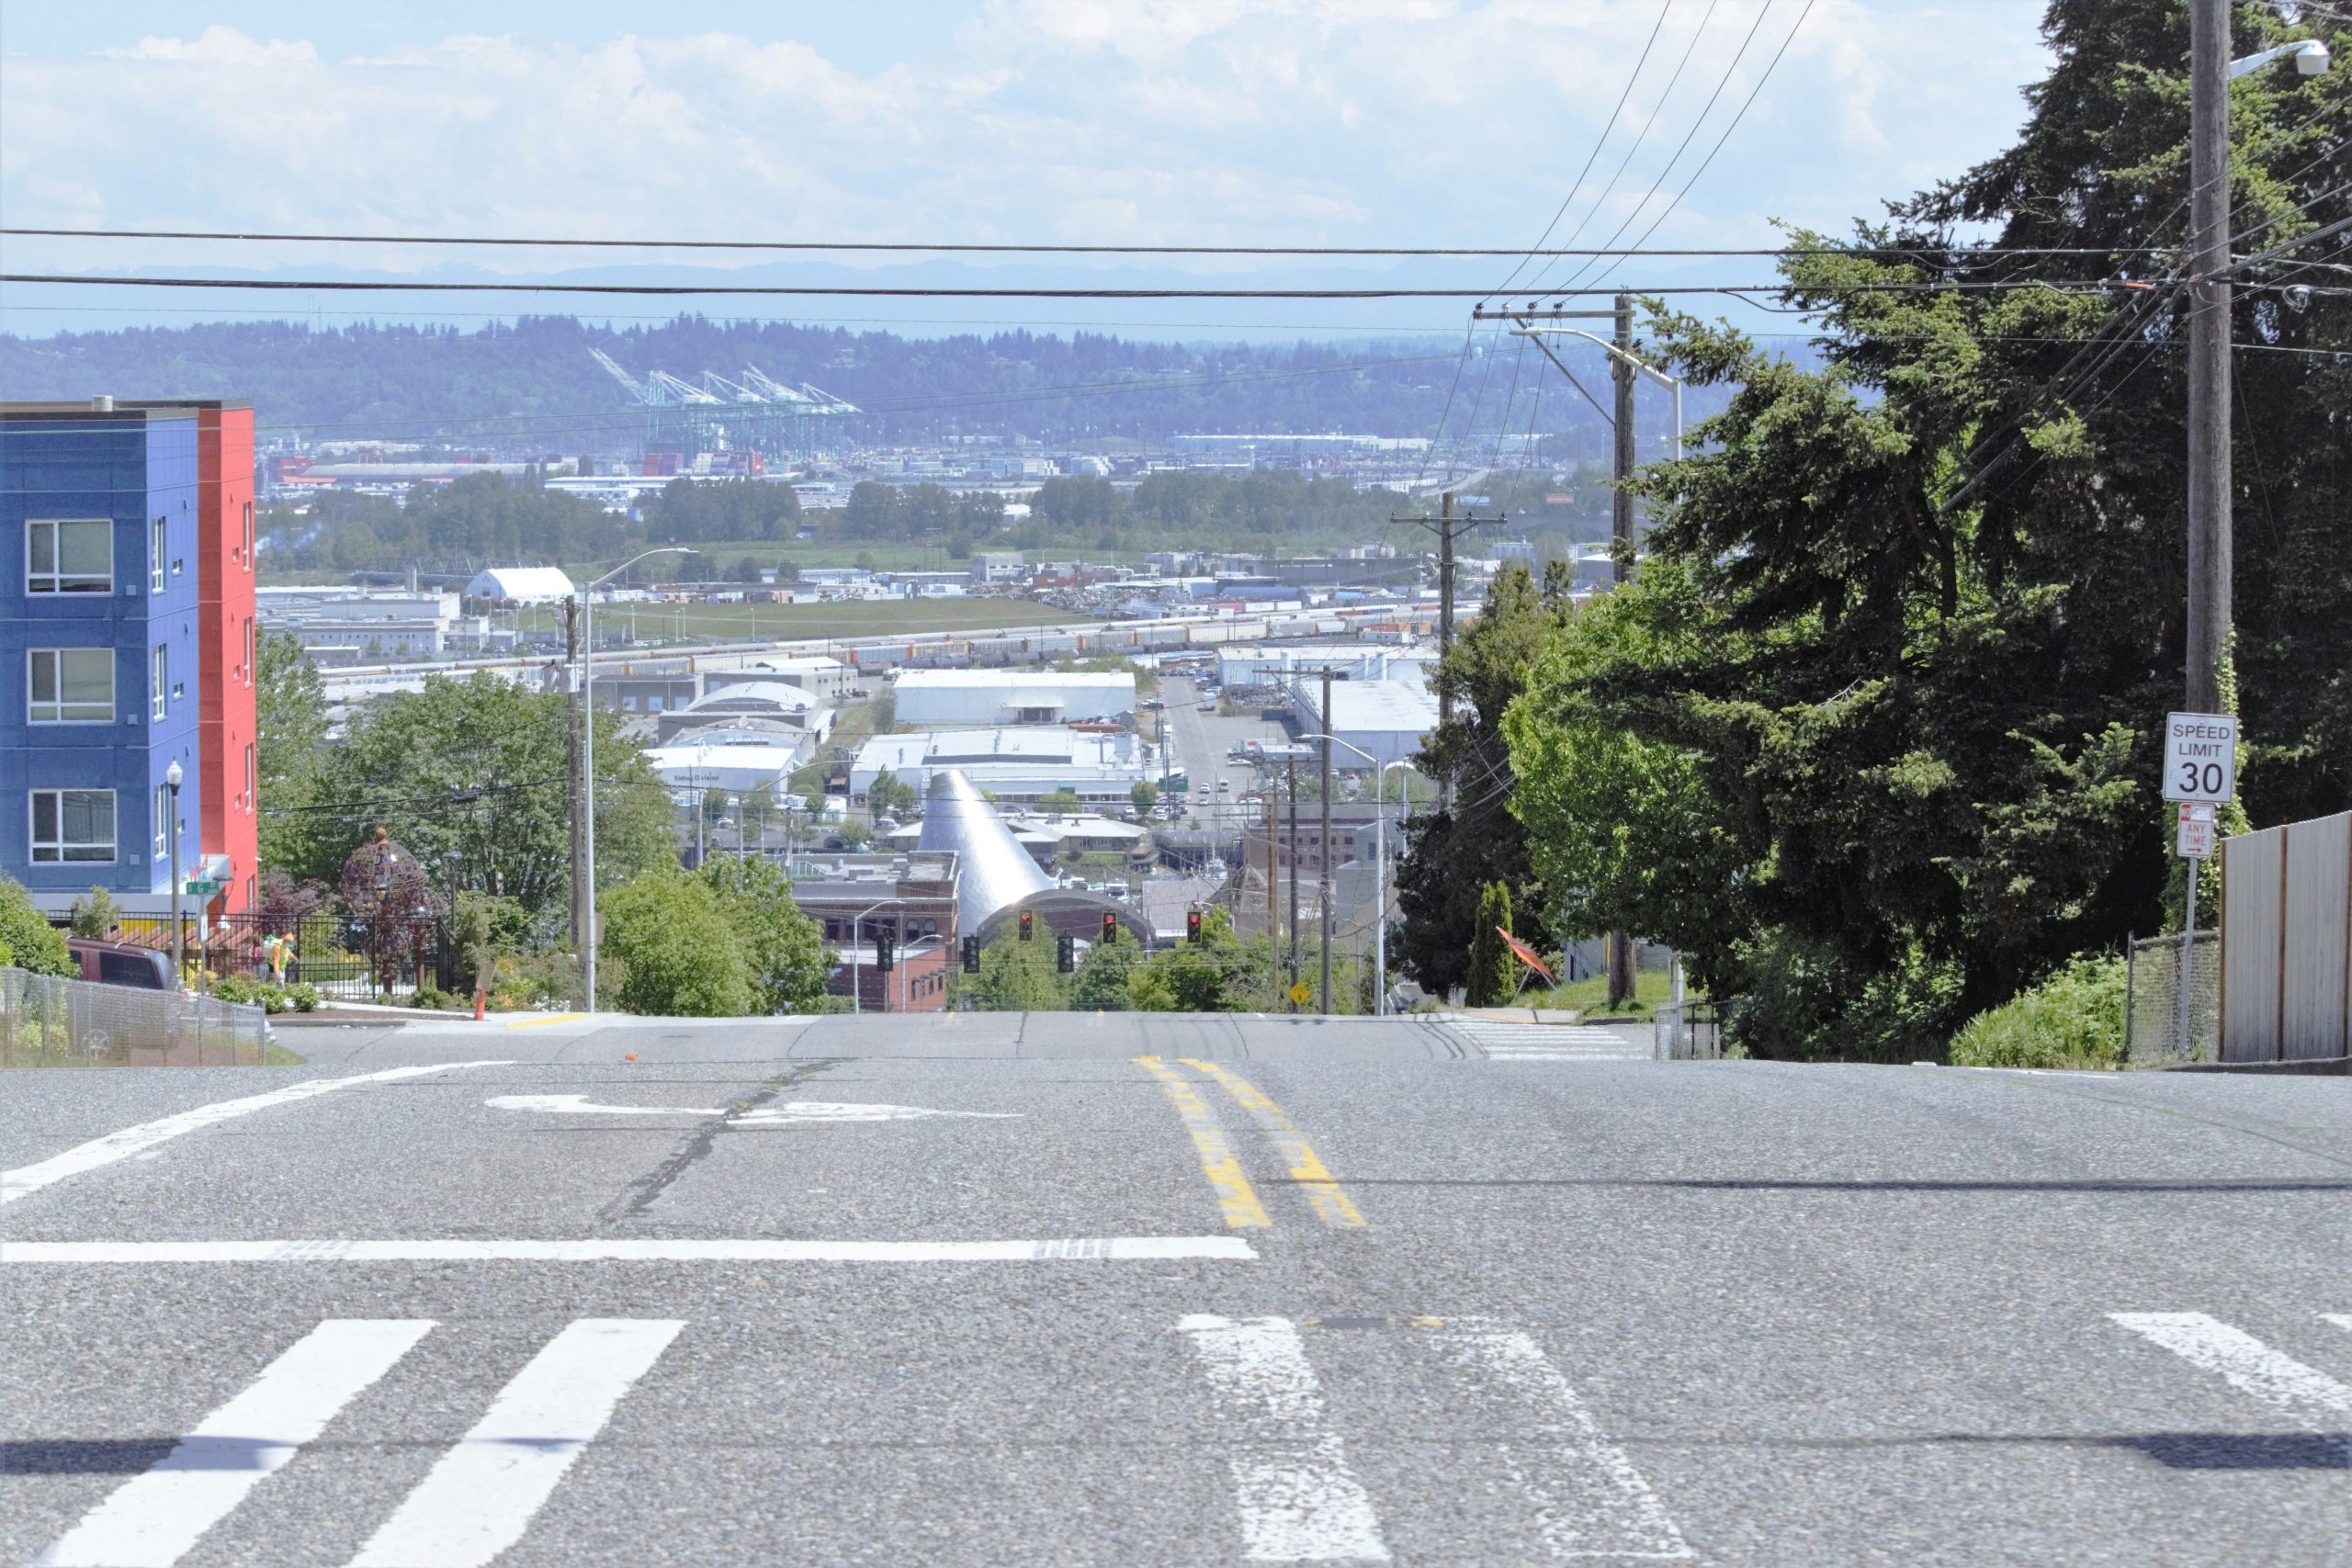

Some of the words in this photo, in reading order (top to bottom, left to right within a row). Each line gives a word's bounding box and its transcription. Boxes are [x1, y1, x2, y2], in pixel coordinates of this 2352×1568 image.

[2173, 724, 2230, 739] SPEED
[2178, 742, 2222, 758] LIMIT
[2178, 761, 2223, 795] 30
[2187, 823, 2205, 833] ANY
[2185, 835, 2206, 846] TIME
